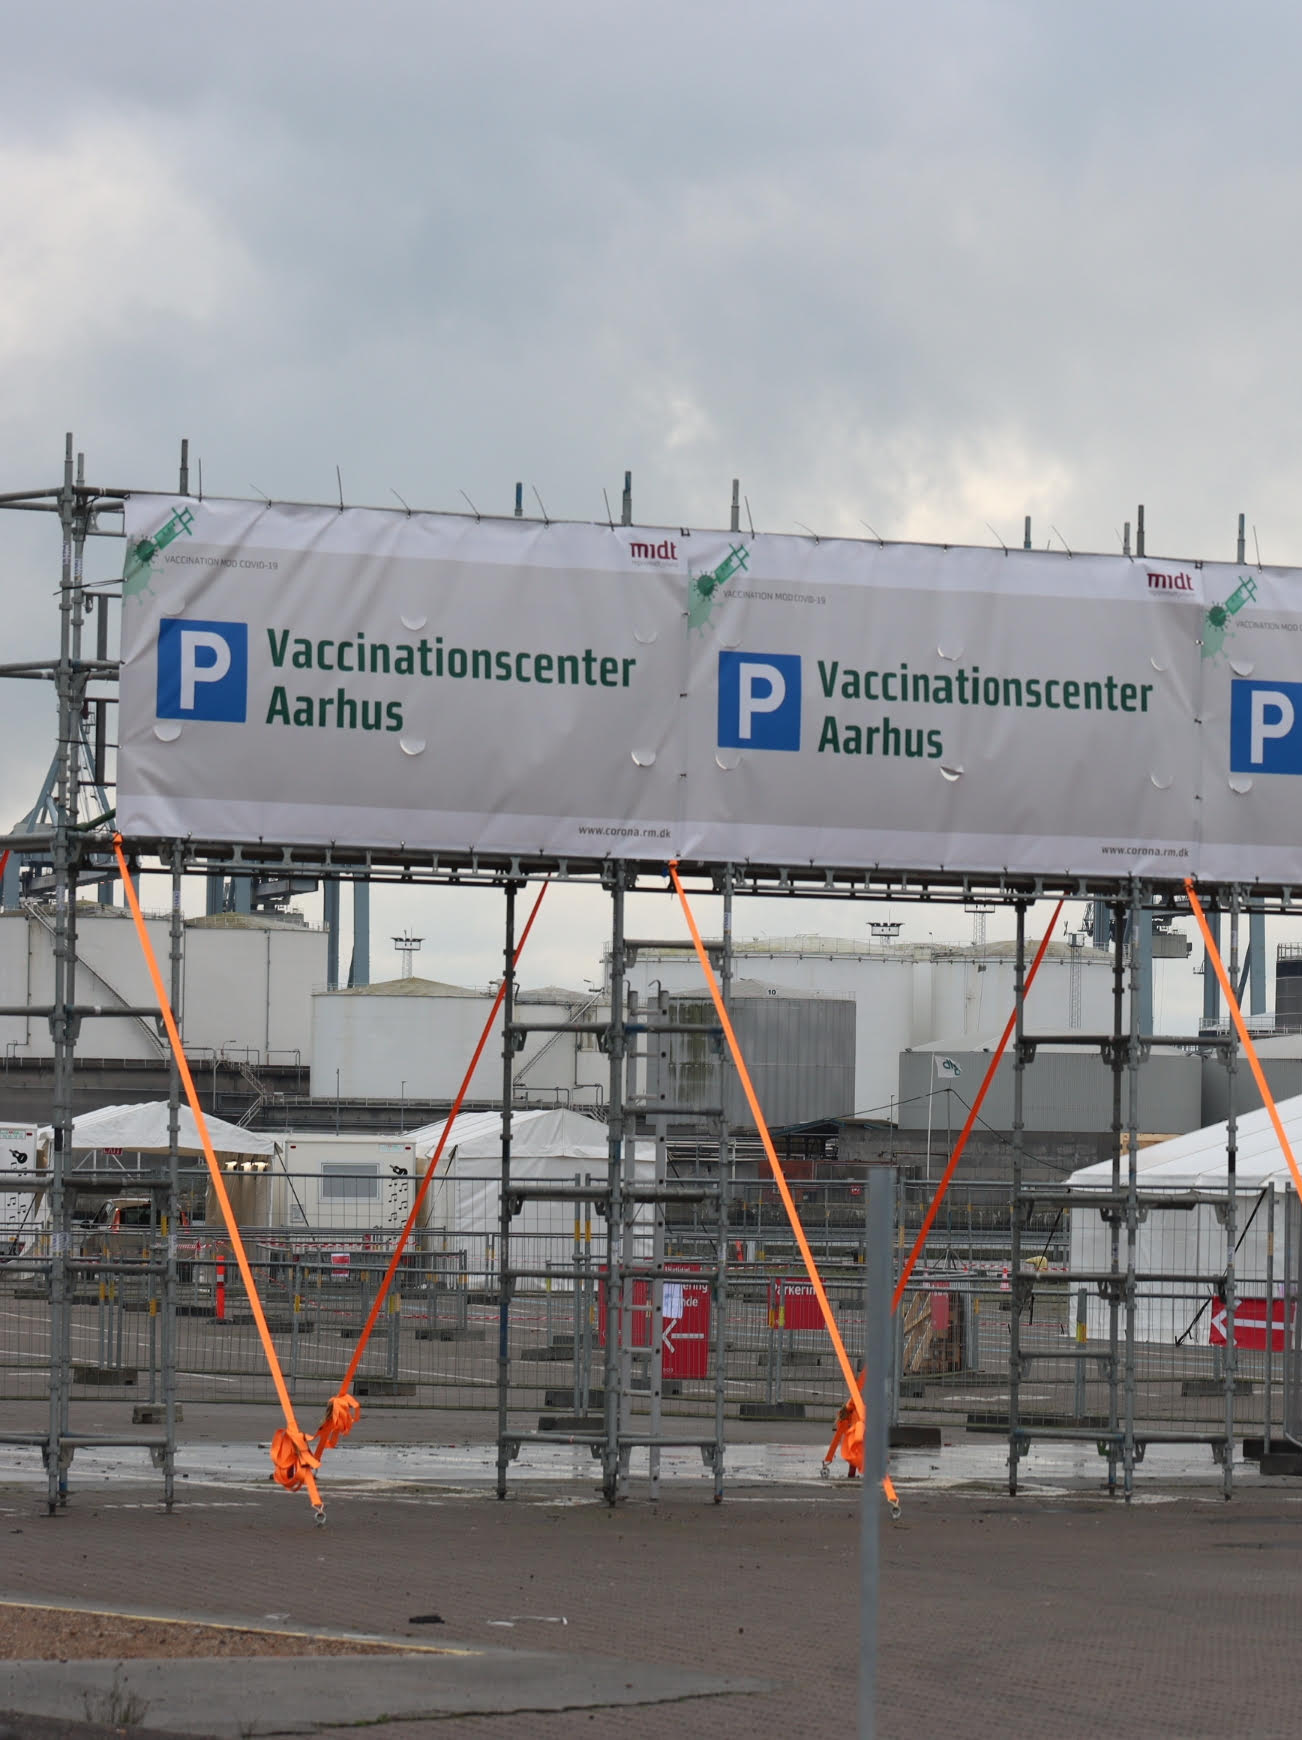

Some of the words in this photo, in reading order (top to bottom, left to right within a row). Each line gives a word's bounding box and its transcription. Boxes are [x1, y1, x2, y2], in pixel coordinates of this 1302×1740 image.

[164, 556, 219, 567] VACCINATION
[220, 559, 238, 568] MOD
[239, 560, 279, 570] COVID-19
[629, 540, 678, 560] midt
[723, 590, 773, 601] VACCINATION
[775, 593, 793, 601] MOD
[1147, 572, 1194, 590] midt
[1236, 620, 1280, 630] VACCINATION
[1281, 623, 1299, 632] MOD
[179, 630, 232, 710] P
[266, 628, 637, 688] Vaccinationscenter
[738, 662, 786, 739] P
[817, 660, 1154, 712] Vaccinationscenter
[265, 686, 404, 731] Aarhus
[818, 715, 943, 758] Aarhus
[1250, 690, 1295, 764] P
[578, 825, 672, 839] www.corona.rm.dk
[1101, 846, 1189, 858] www.corona.rm.dk
